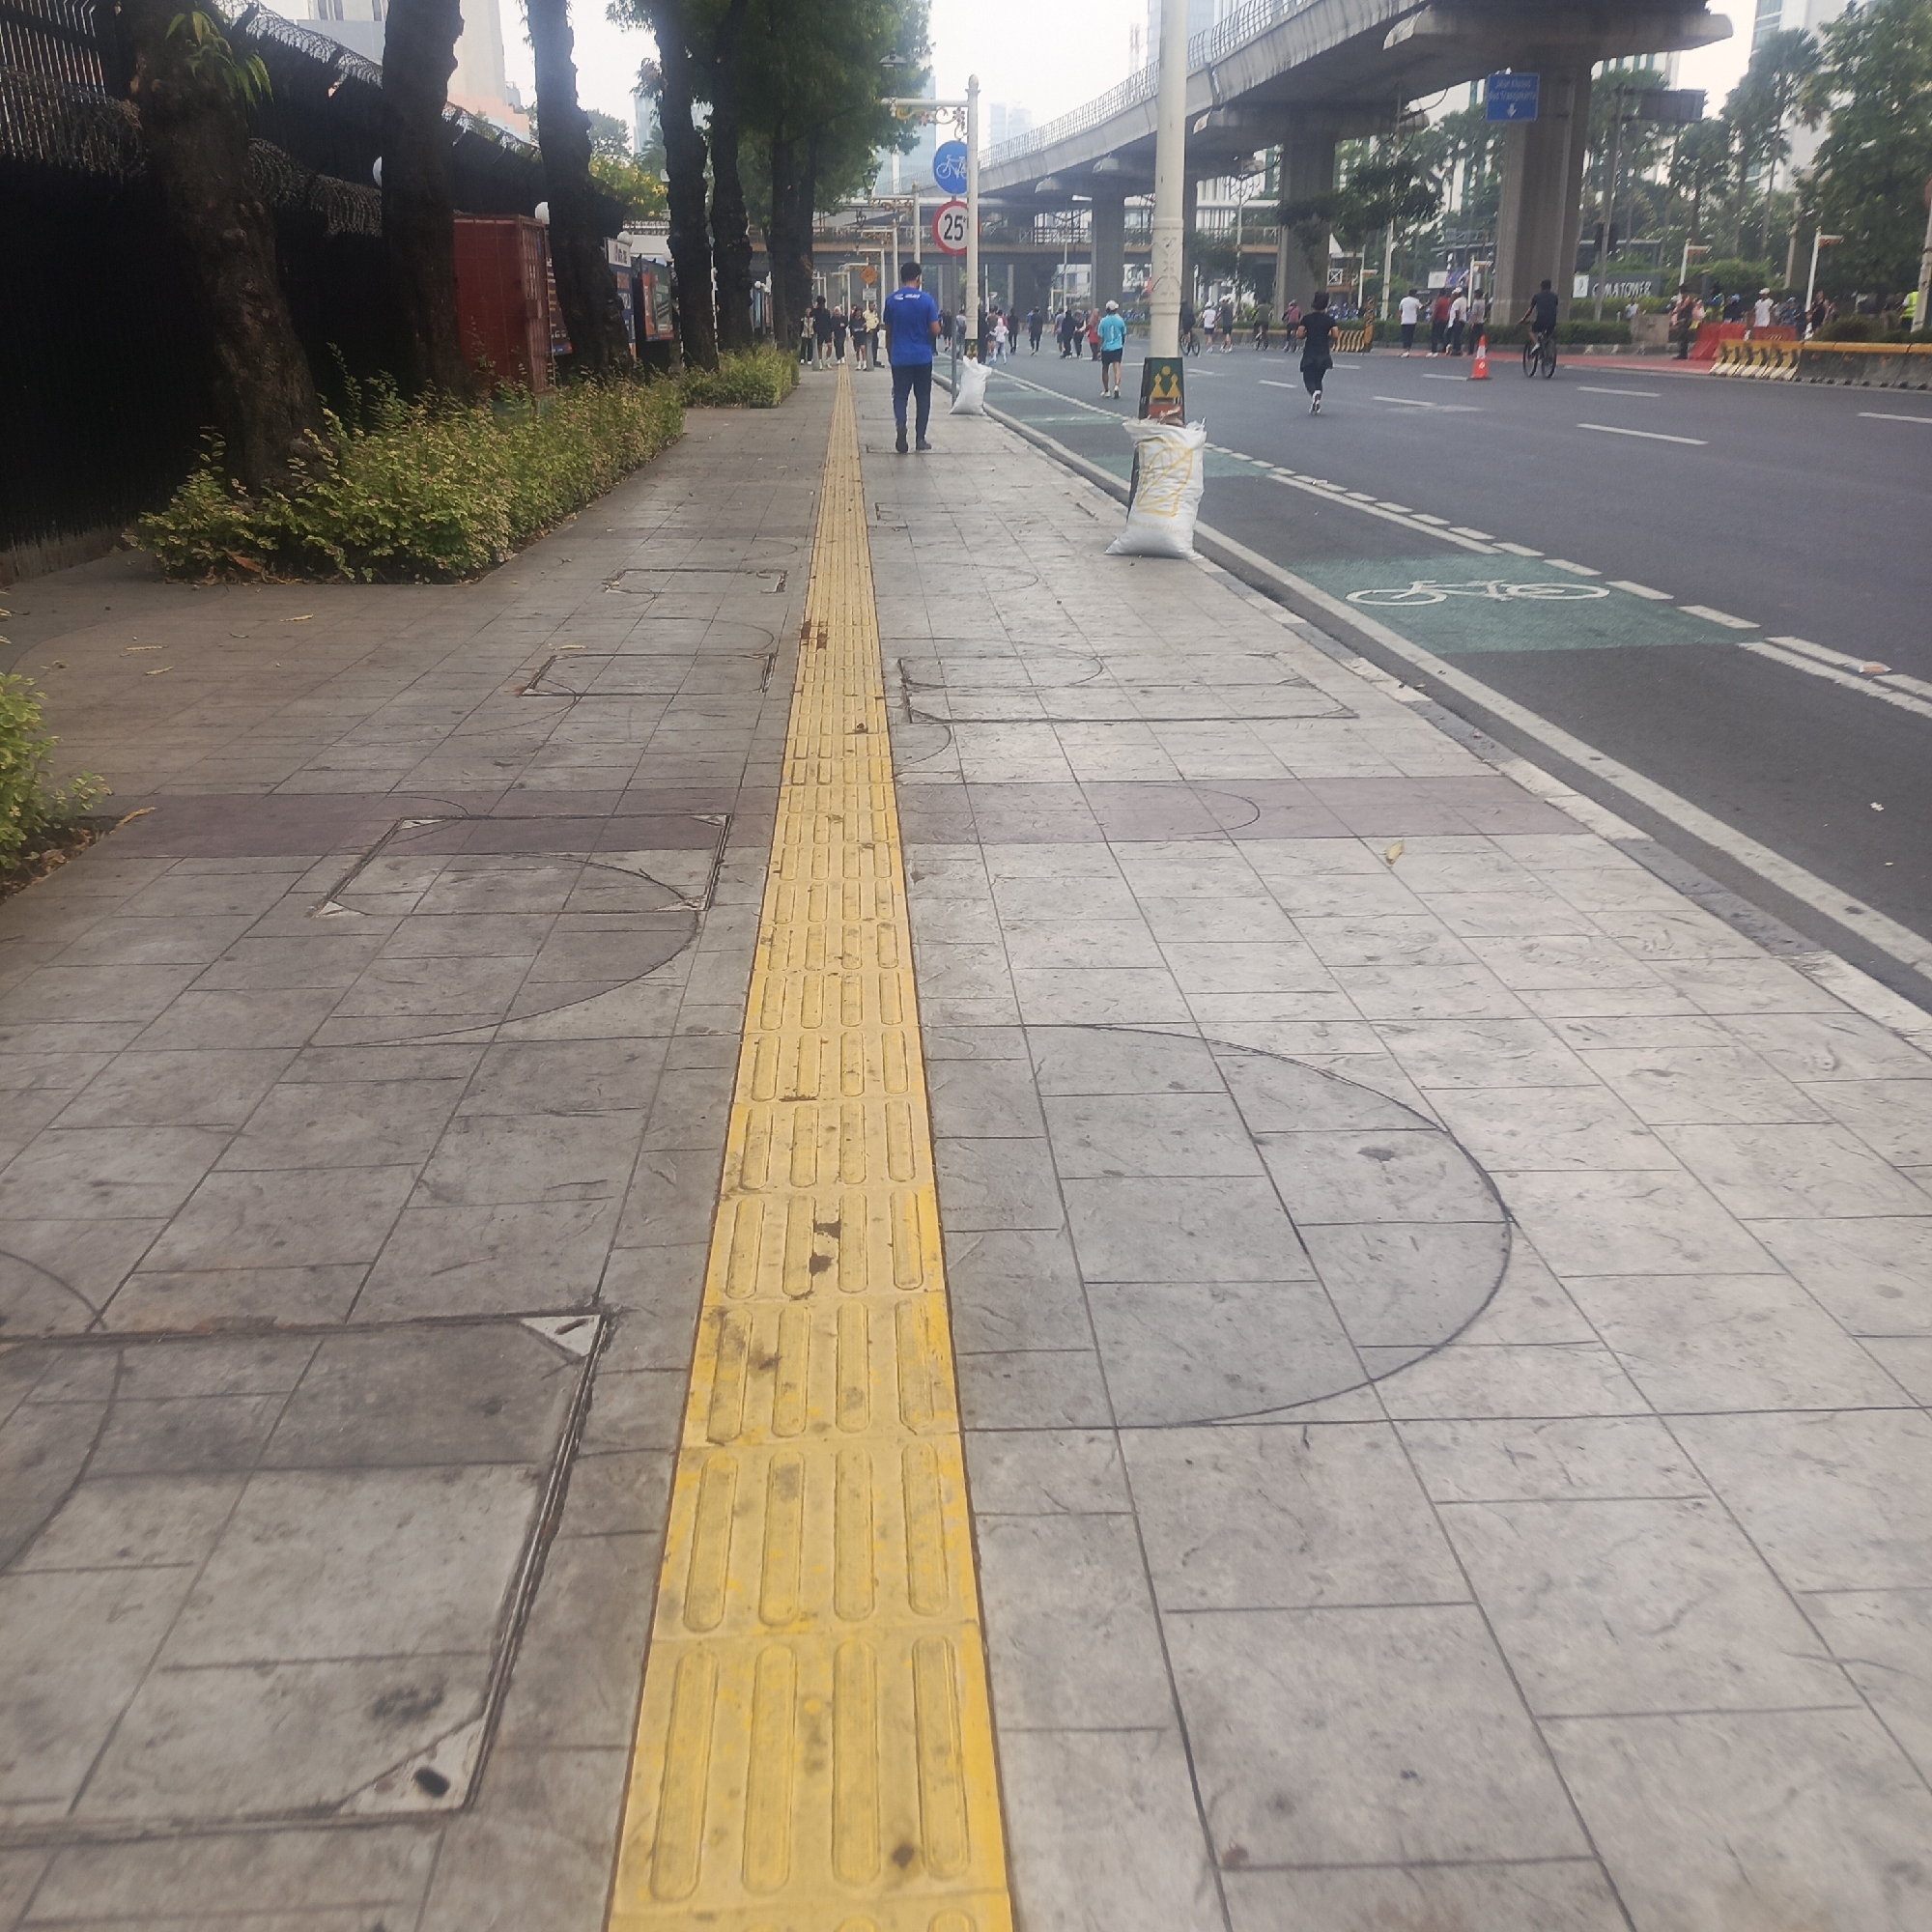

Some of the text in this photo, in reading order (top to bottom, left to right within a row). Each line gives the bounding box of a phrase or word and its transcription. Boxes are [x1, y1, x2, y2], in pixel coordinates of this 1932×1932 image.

[944, 213, 964, 241] 25
[1592, 281, 1652, 298] MA TOWER
